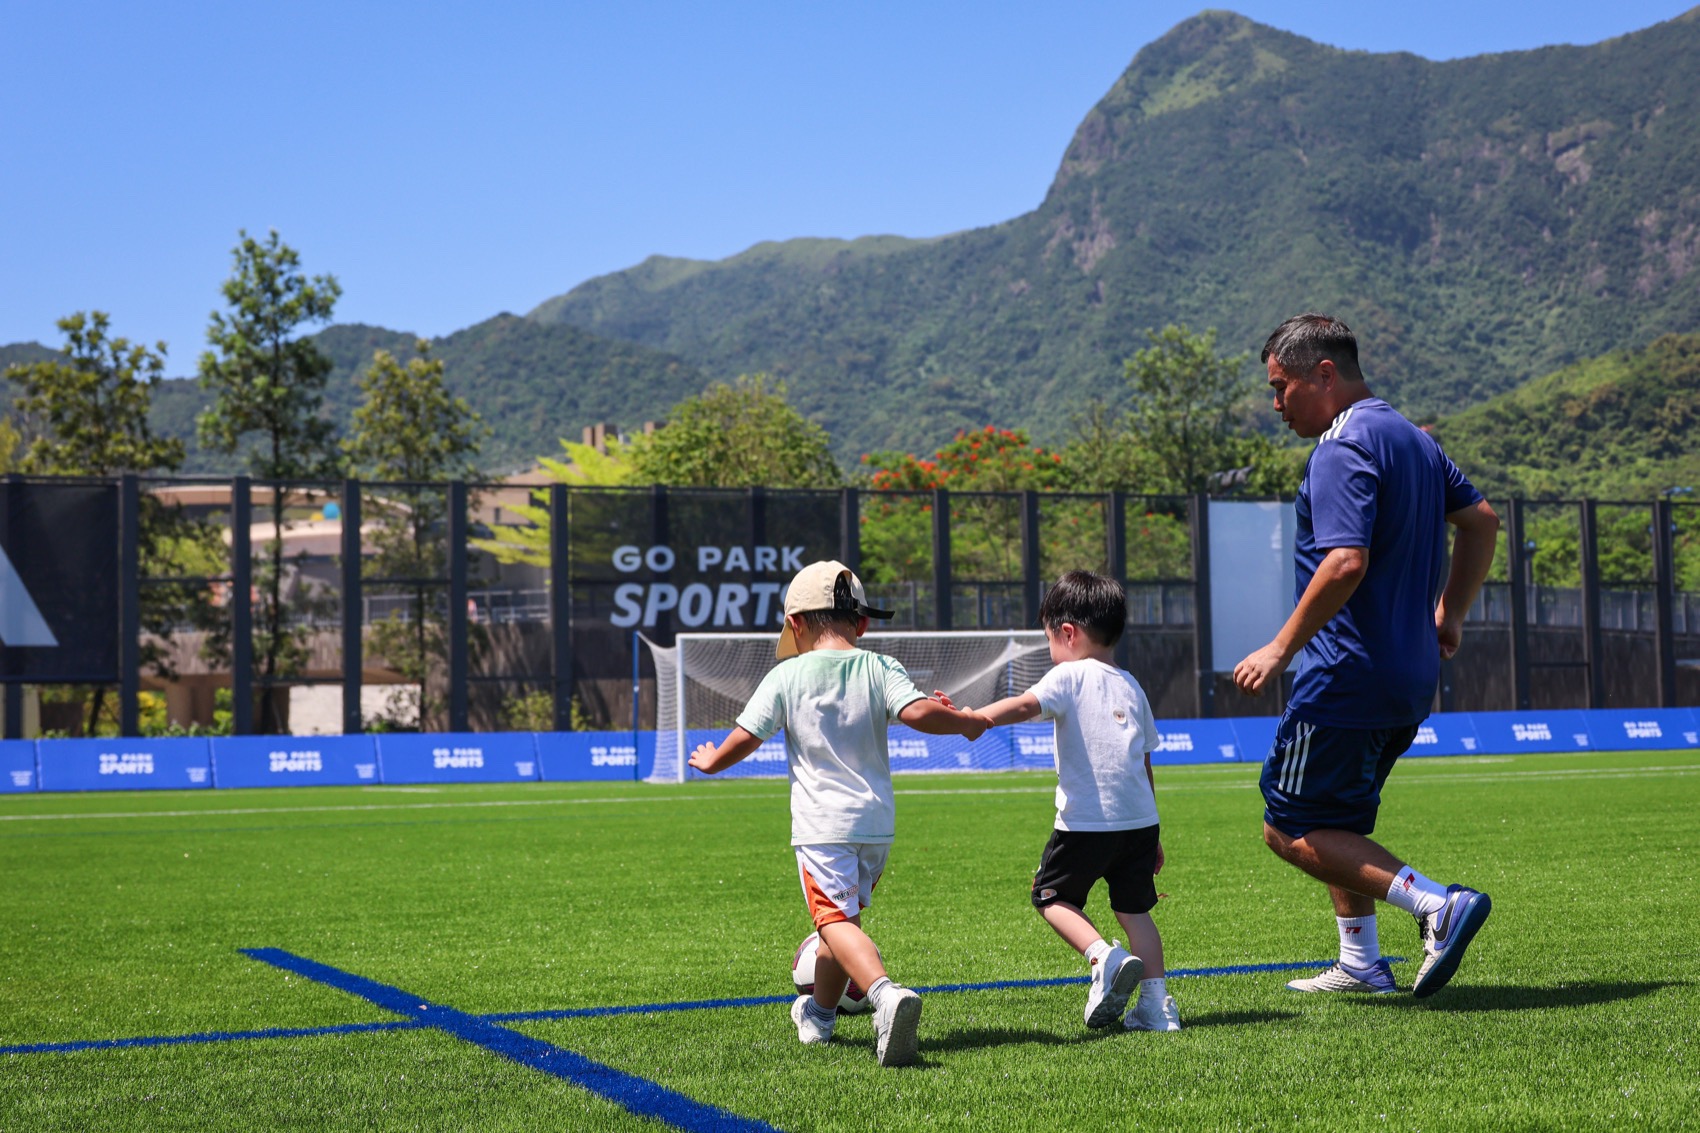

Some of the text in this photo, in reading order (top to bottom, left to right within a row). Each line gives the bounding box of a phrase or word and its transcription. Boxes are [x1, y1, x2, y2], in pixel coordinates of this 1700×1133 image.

[612, 545, 805, 572] GO PARK
[99, 762, 154, 774] SPORTS
[269, 760, 322, 772] SPORTS
[433, 756, 484, 768] SPORTS
